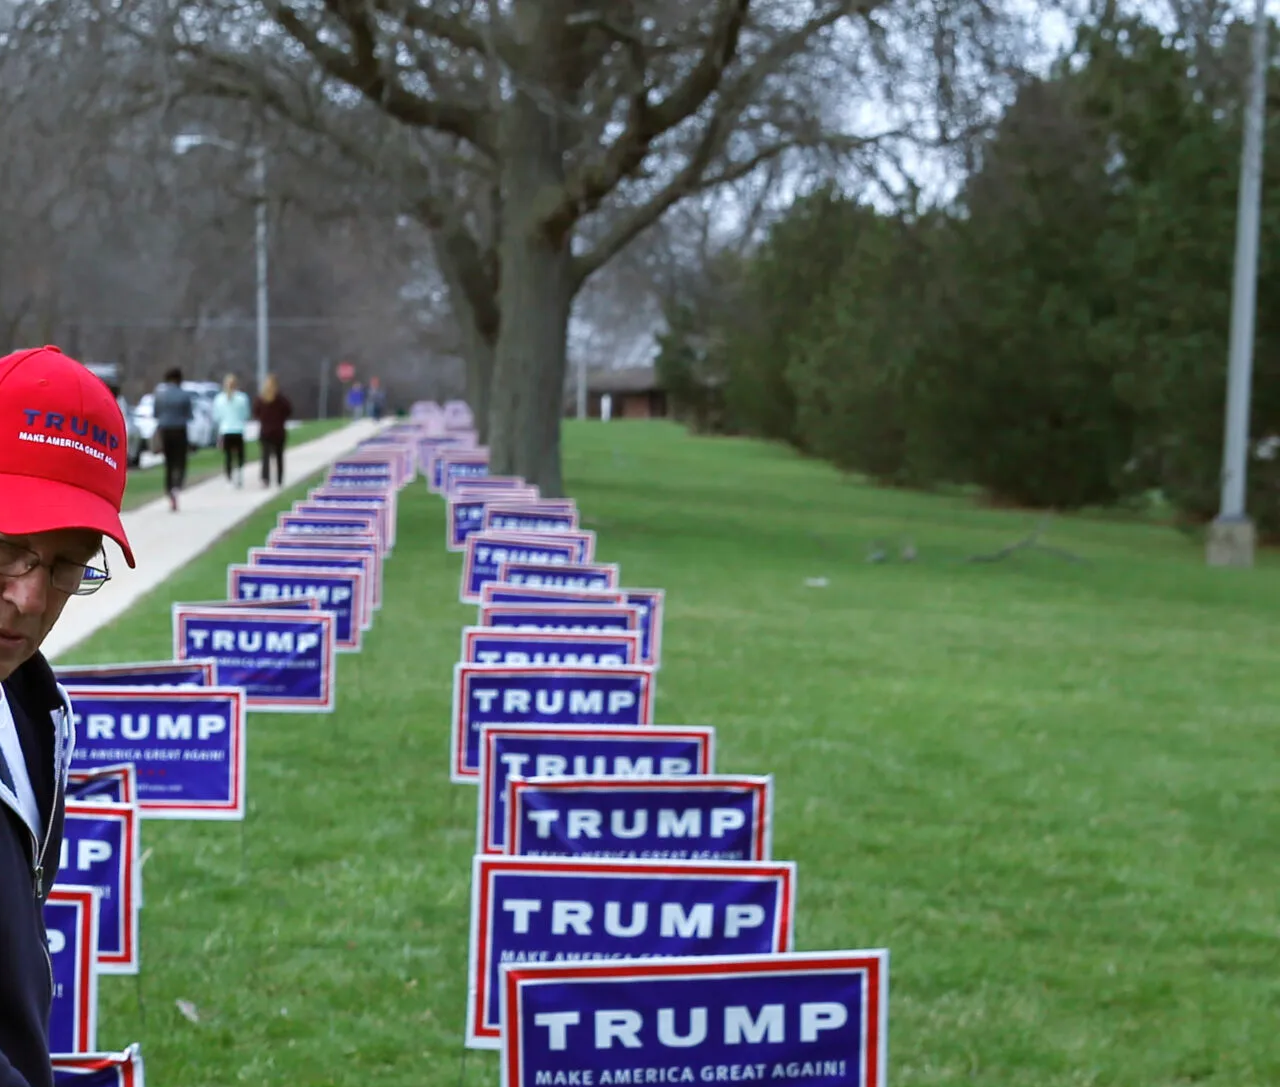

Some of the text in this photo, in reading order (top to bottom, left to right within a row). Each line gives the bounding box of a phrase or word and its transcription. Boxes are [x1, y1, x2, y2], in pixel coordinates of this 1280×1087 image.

[22, 408, 119, 452] TRUMP
[19, 431, 45, 443] MAKE
[45, 436, 85, 452] AMERICA
[84, 446, 105, 461] GREAT
[188, 628, 319, 653] TRUMP
[472, 688, 635, 714] TRUMP
[74, 713, 227, 741] RUMP
[500, 753, 692, 778] TRUMP
[527, 808, 746, 839] TRUMP
[503, 899, 765, 939] TRUMP
[534, 1002, 848, 1051] TRUMP
[535, 1060, 846, 1086] MAKE AMERICA GREAT AGAIN!
